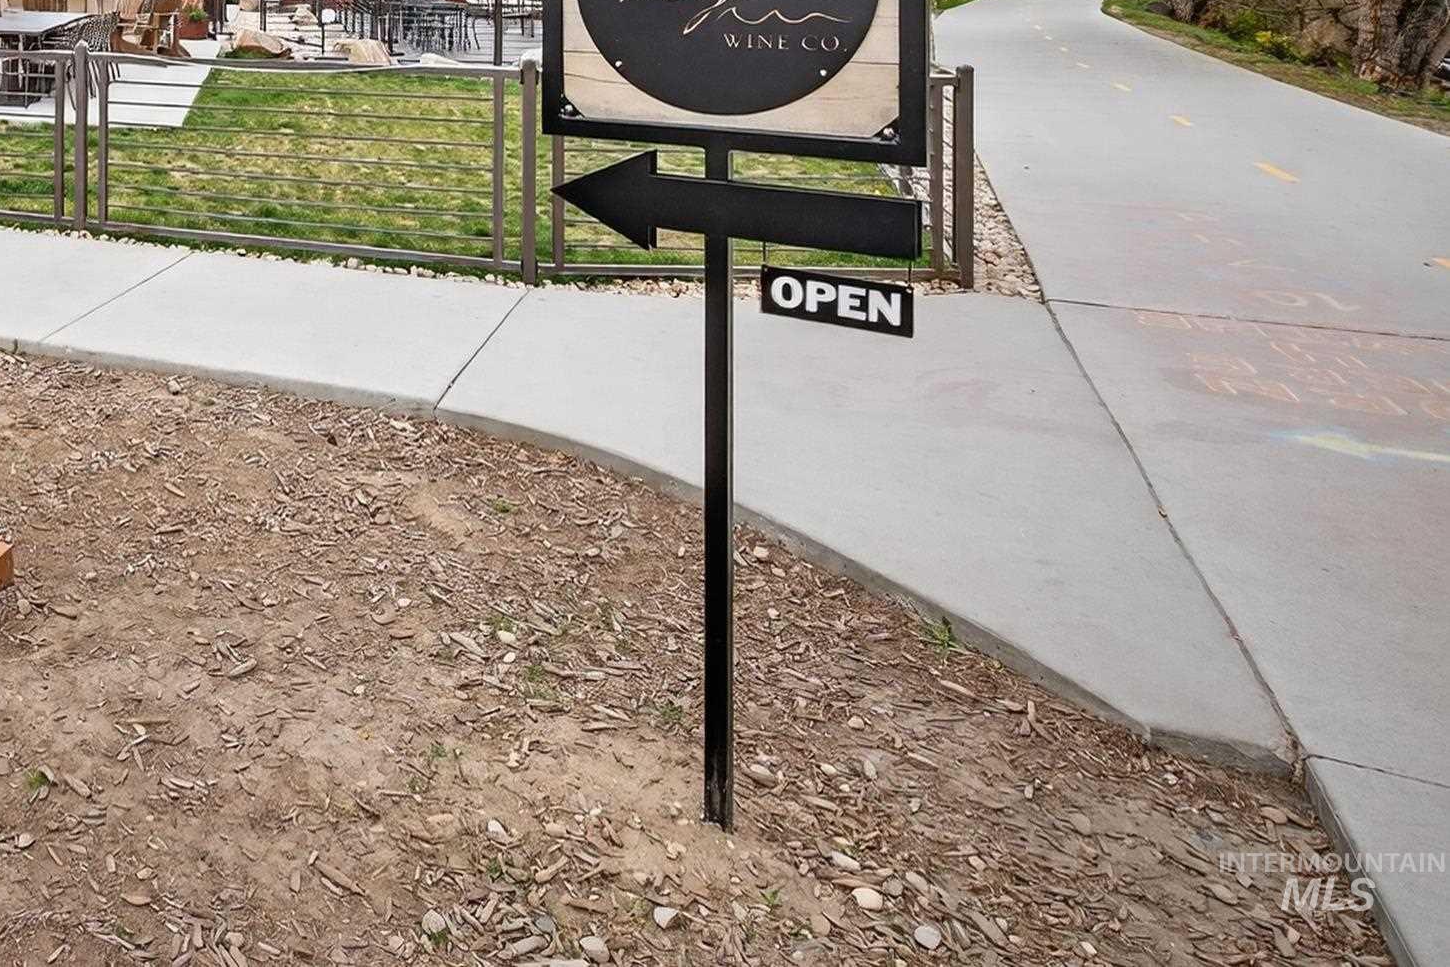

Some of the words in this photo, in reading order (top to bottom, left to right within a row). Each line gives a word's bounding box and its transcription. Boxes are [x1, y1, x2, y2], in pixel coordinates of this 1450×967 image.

[723, 33, 790, 50] WINE
[801, 34, 848, 52] CO.
[770, 275, 902, 327] OPEN
